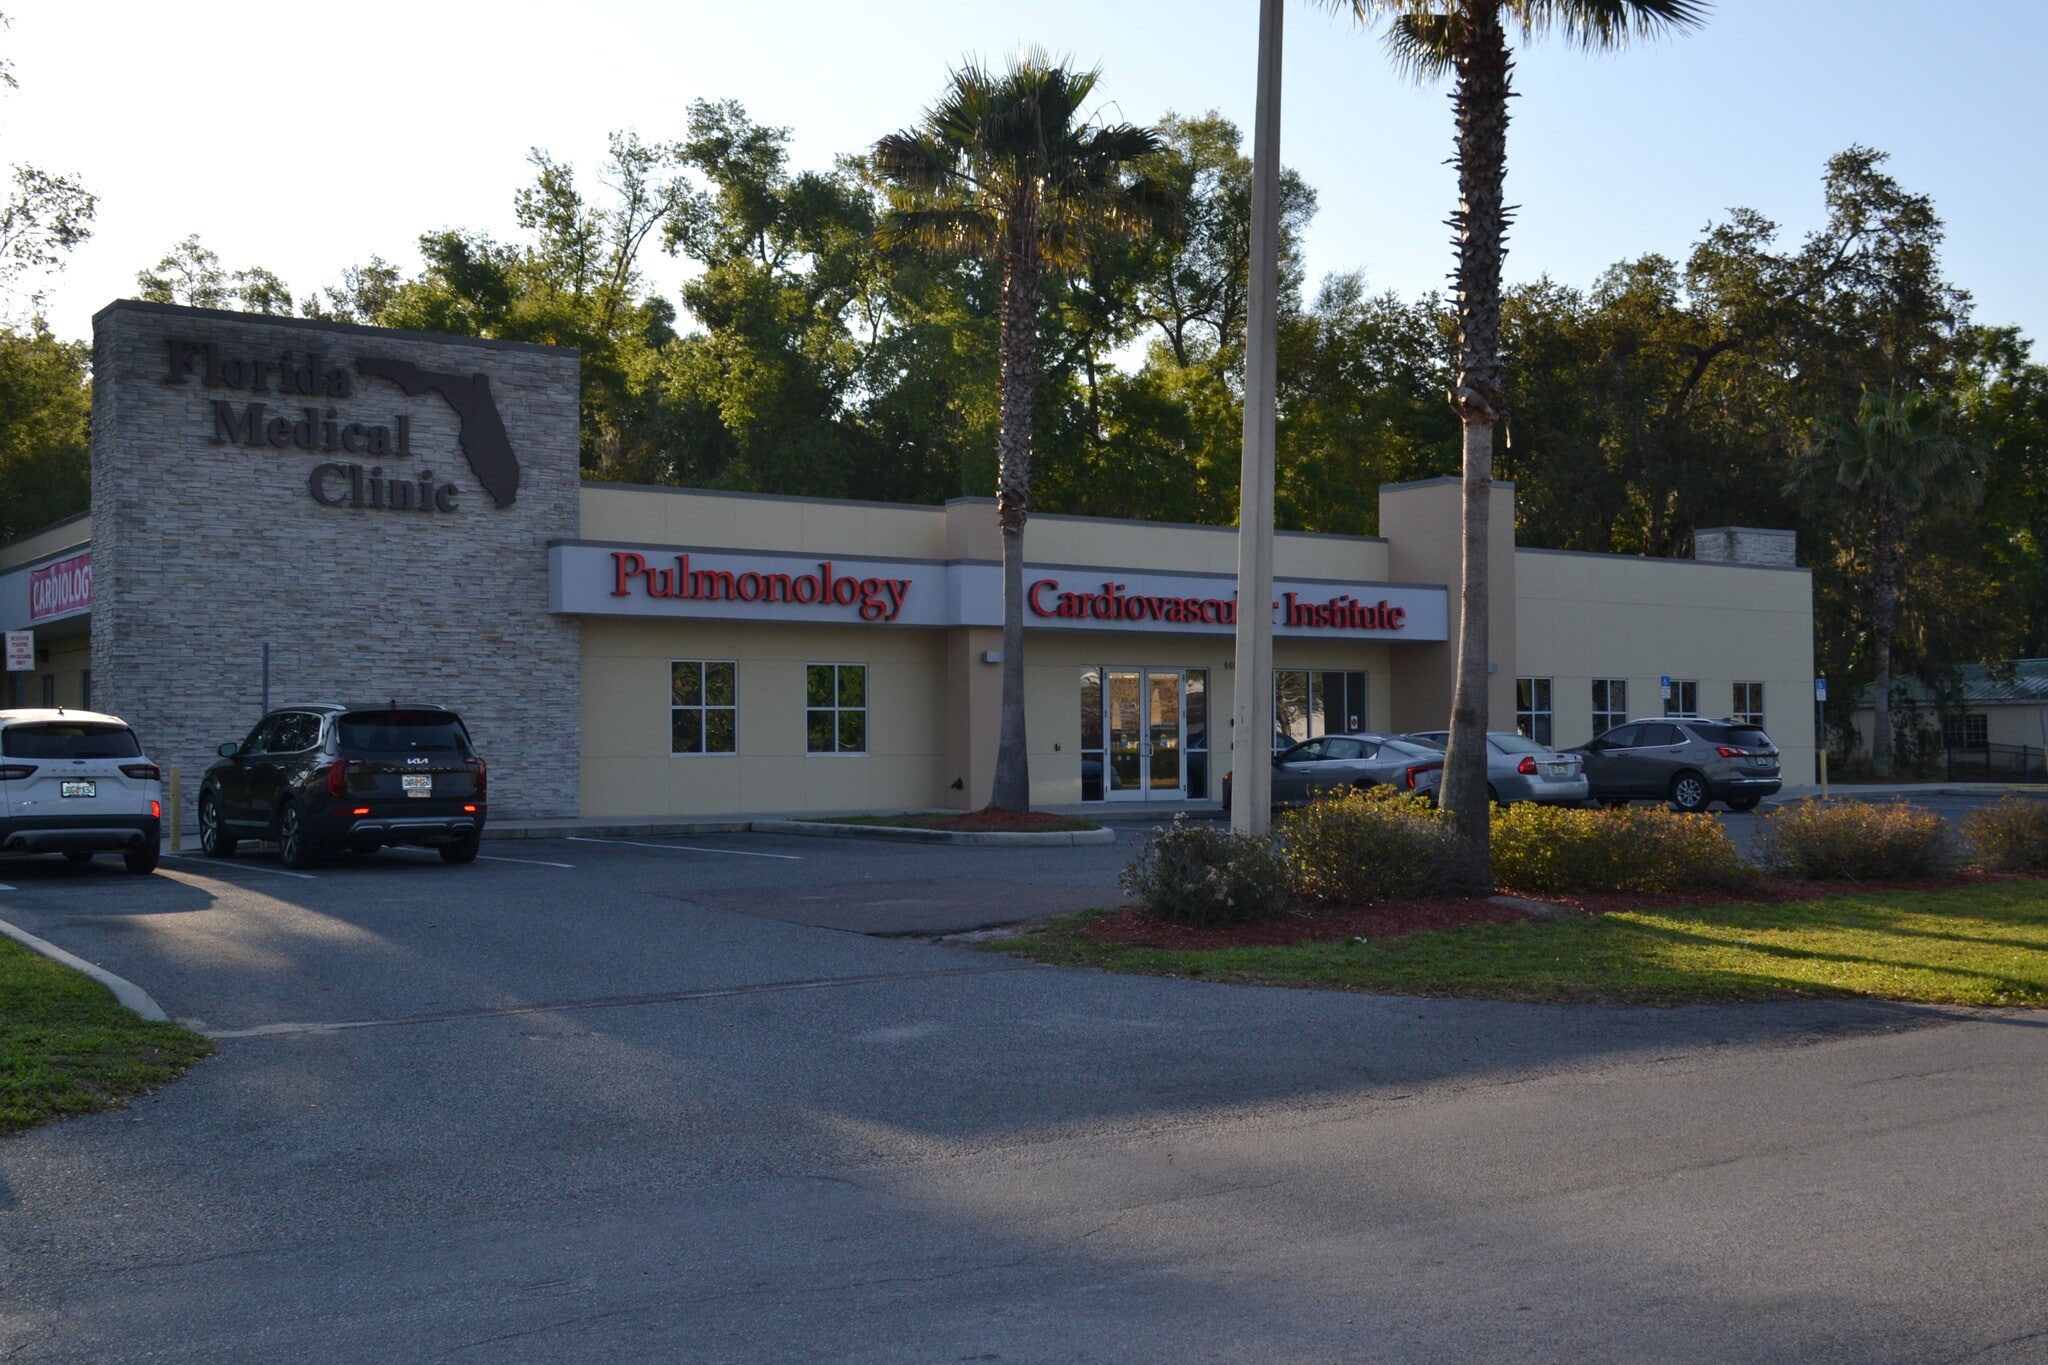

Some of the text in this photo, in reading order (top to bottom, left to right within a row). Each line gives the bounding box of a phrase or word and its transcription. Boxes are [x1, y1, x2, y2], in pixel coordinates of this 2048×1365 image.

[165, 338, 352, 398] Florida
[209, 399, 412, 457] Medical
[309, 463, 459, 512] Clinic
[610, 551, 912, 621] Pulmonology
[1027, 579, 1406, 630] Cardiovascu Institute
